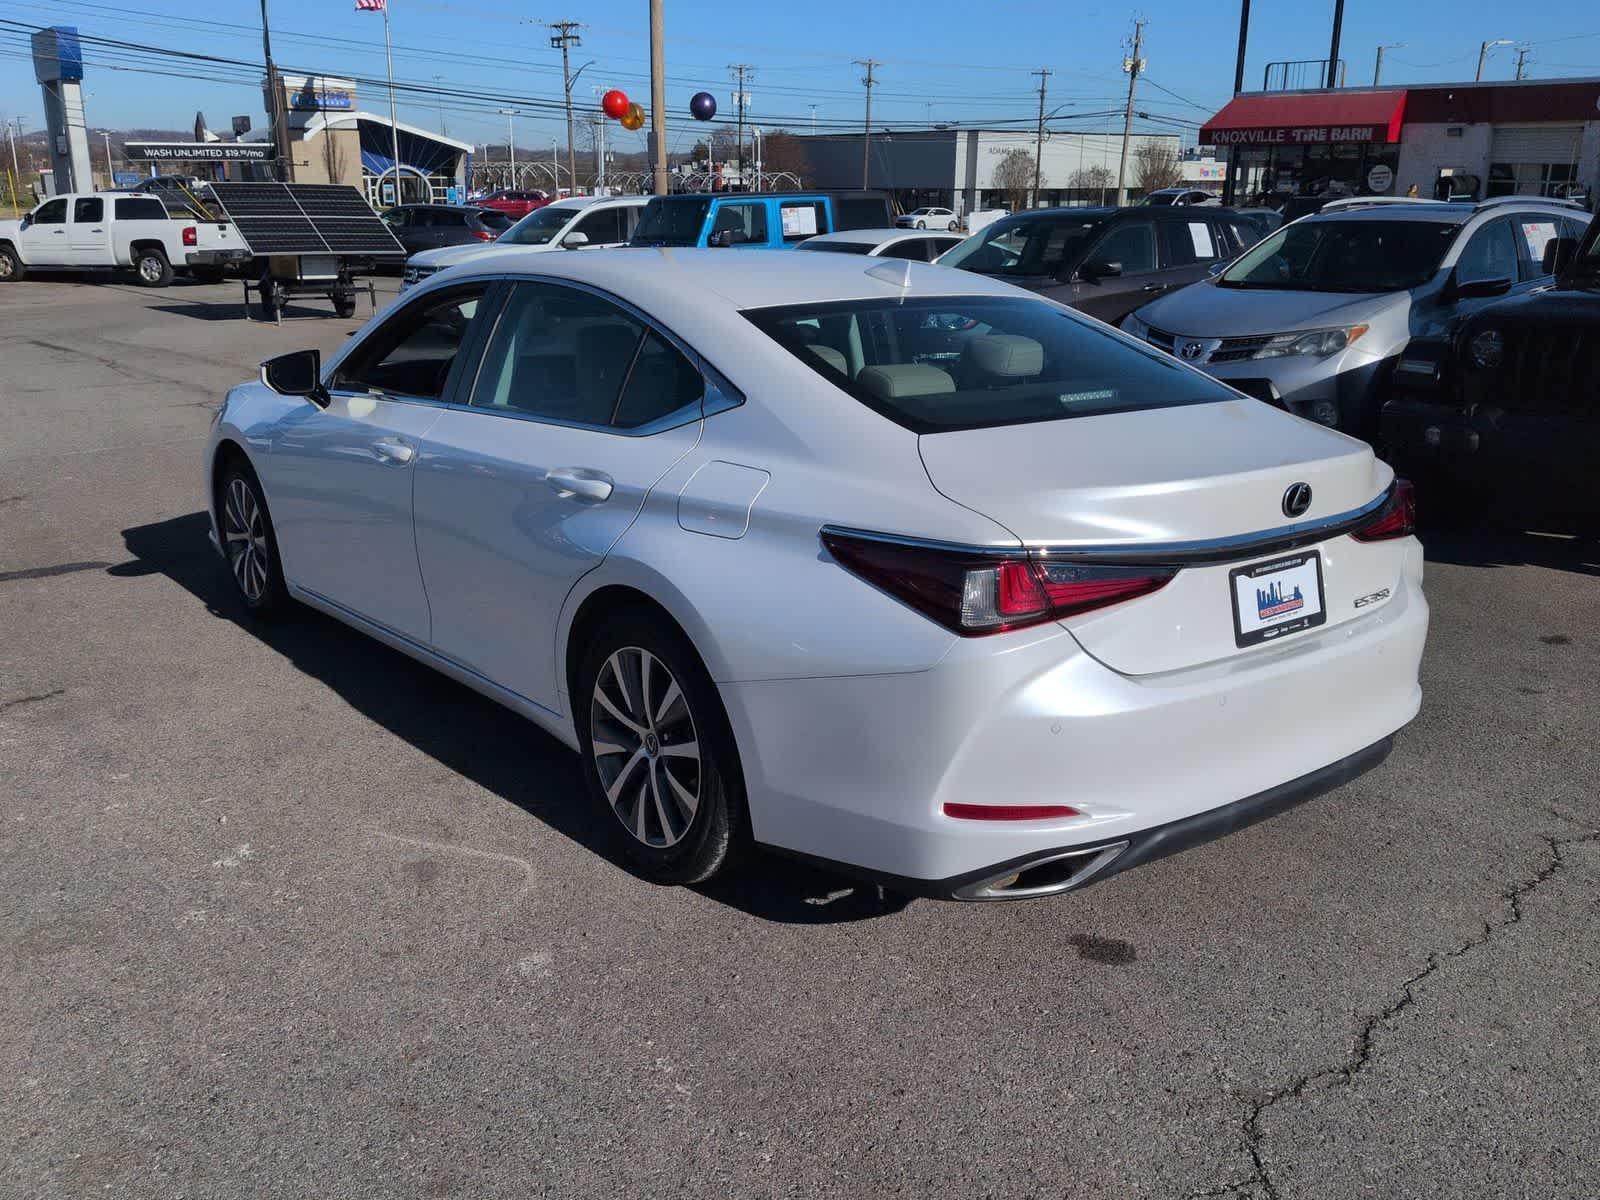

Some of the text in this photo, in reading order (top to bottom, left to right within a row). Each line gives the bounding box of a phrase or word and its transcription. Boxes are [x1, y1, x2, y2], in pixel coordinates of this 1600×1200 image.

[1211, 129, 1285, 143] KNOXVILLE
[1331, 127, 1373, 141] BARN
[144, 149, 172, 157] WASH
[174, 149, 222, 157] UNLIMITED
